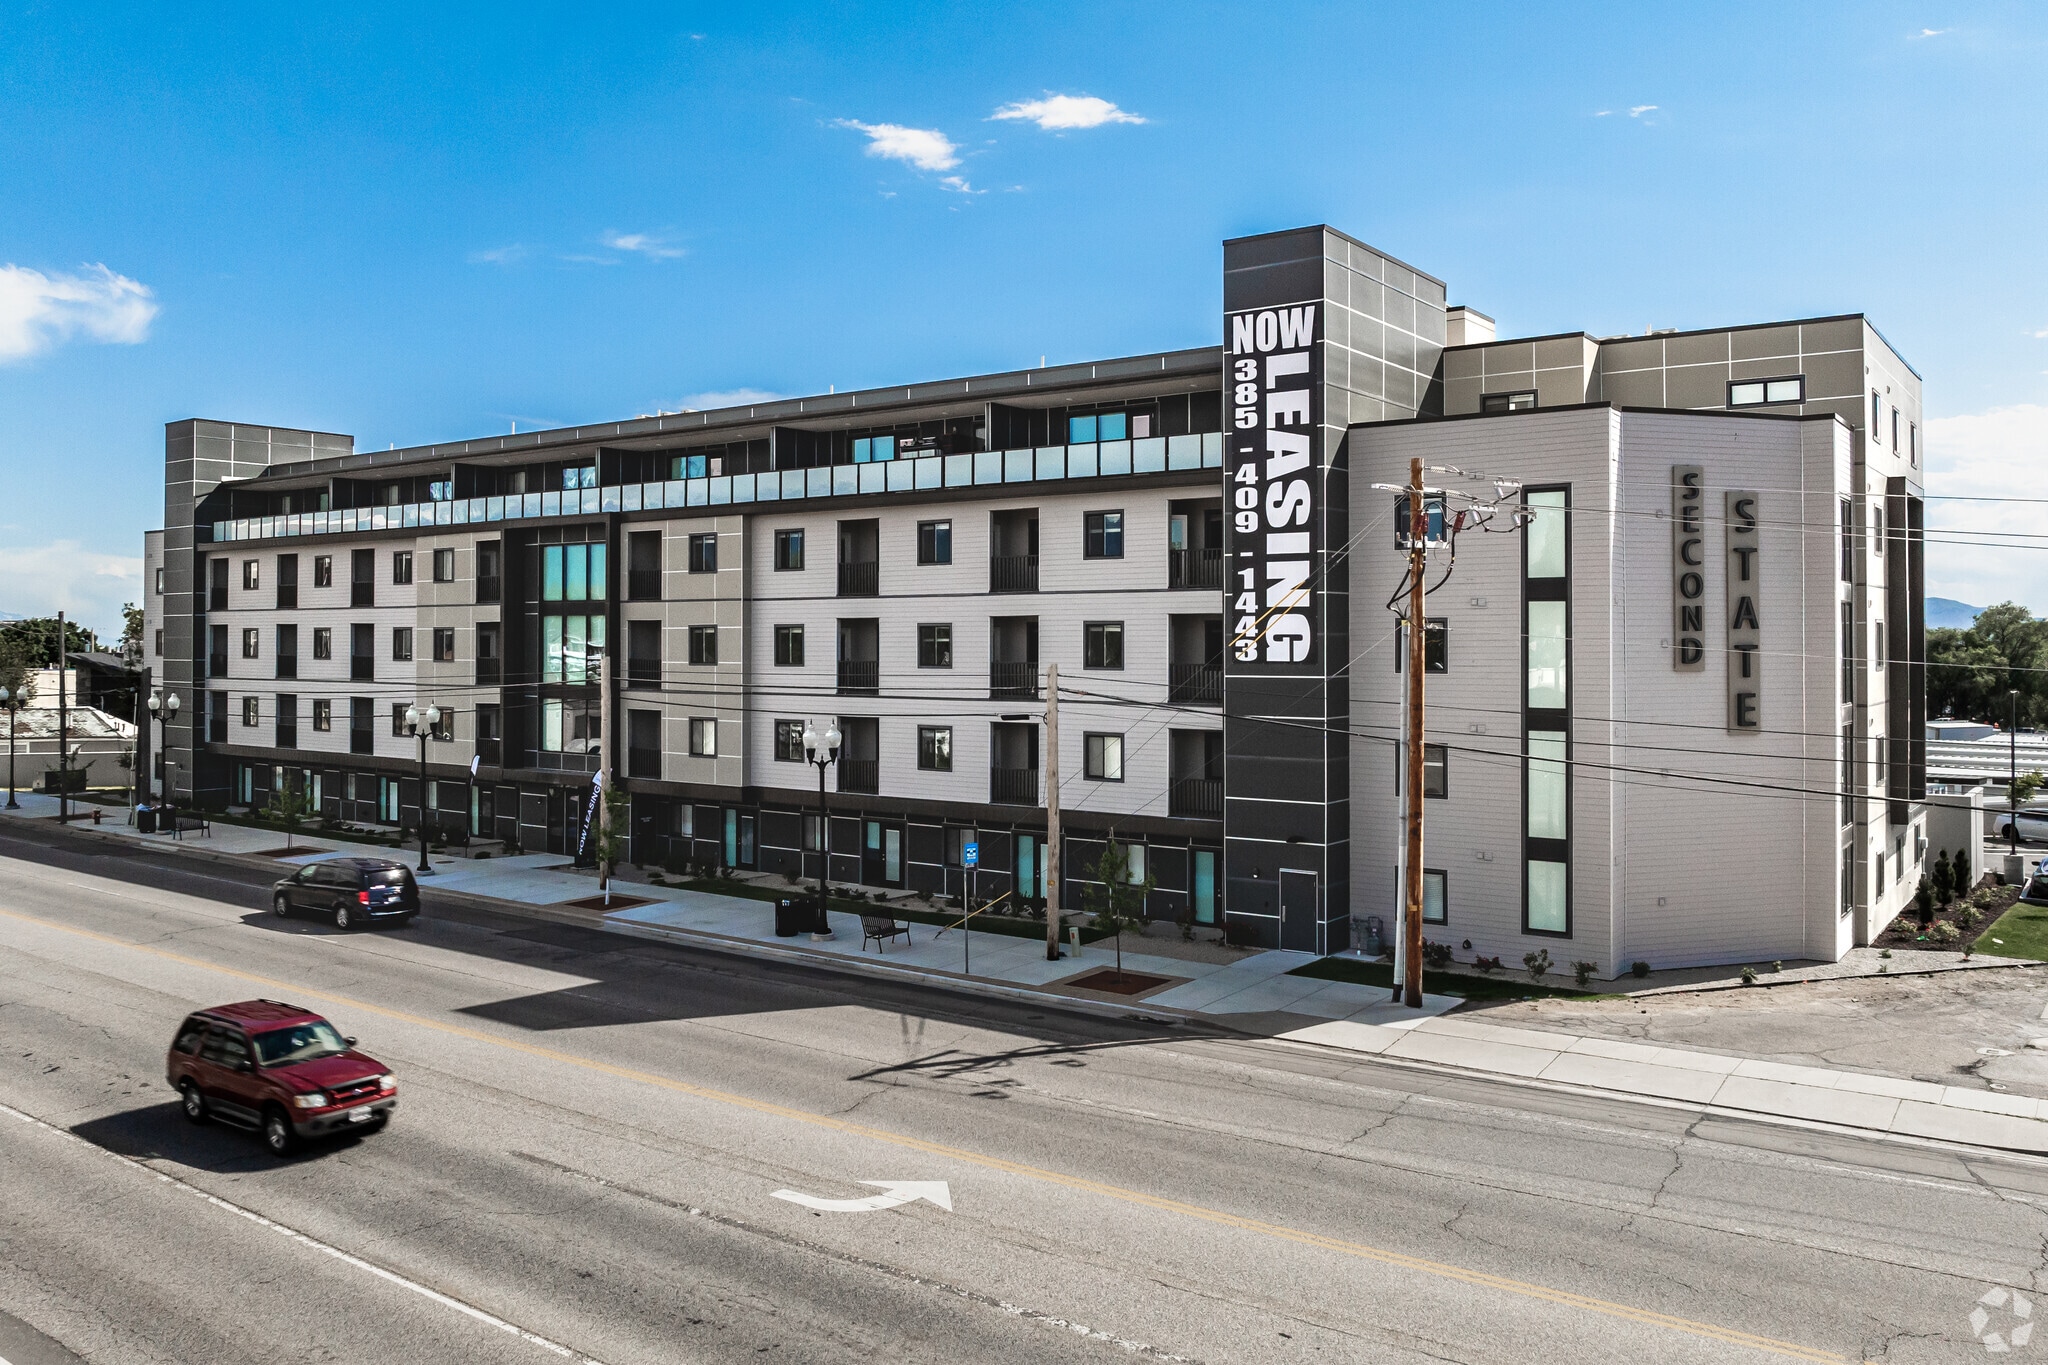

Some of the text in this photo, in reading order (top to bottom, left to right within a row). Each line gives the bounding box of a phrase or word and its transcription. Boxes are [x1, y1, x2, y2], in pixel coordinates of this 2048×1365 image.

[1232, 306, 1315, 355] NOW
[1266, 351, 1310, 663] LEASING
[1680, 472, 1704, 664] SECOND
[1733, 498, 1759, 727] STATE
[583, 784, 601, 829] LEASING
